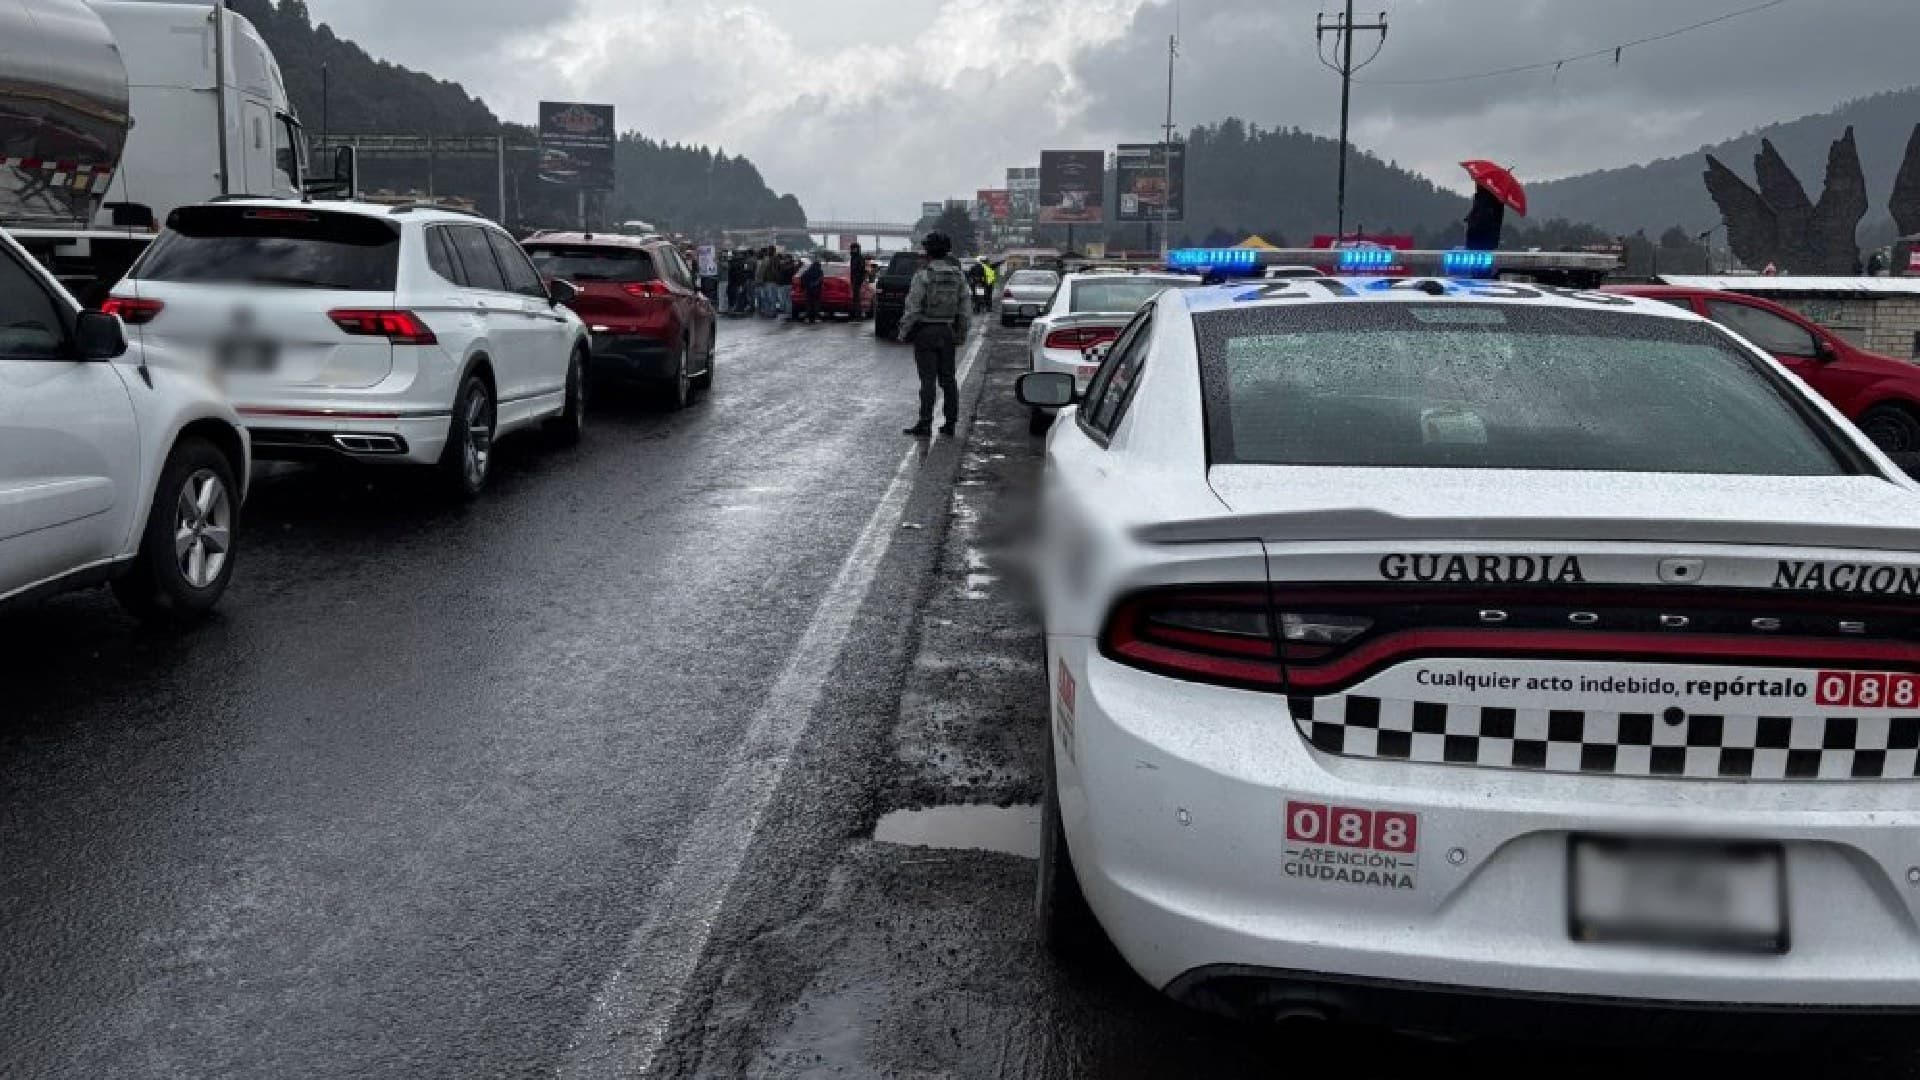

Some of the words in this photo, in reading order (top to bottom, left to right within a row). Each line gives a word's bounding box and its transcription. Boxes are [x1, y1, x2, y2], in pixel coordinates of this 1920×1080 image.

[1379, 553, 1586, 583] GUARDIA
[1478, 609, 1866, 633] DODGE
[1416, 669, 1521, 692] Cualquier
[1526, 675, 1573, 691] acto
[1580, 675, 1681, 697] indebido,
[1686, 675, 1808, 701] repórtalo
[1822, 676, 1914, 704] 088
[1293, 808, 1408, 848] 088
[1284, 862, 1413, 889] CIUDADANA
